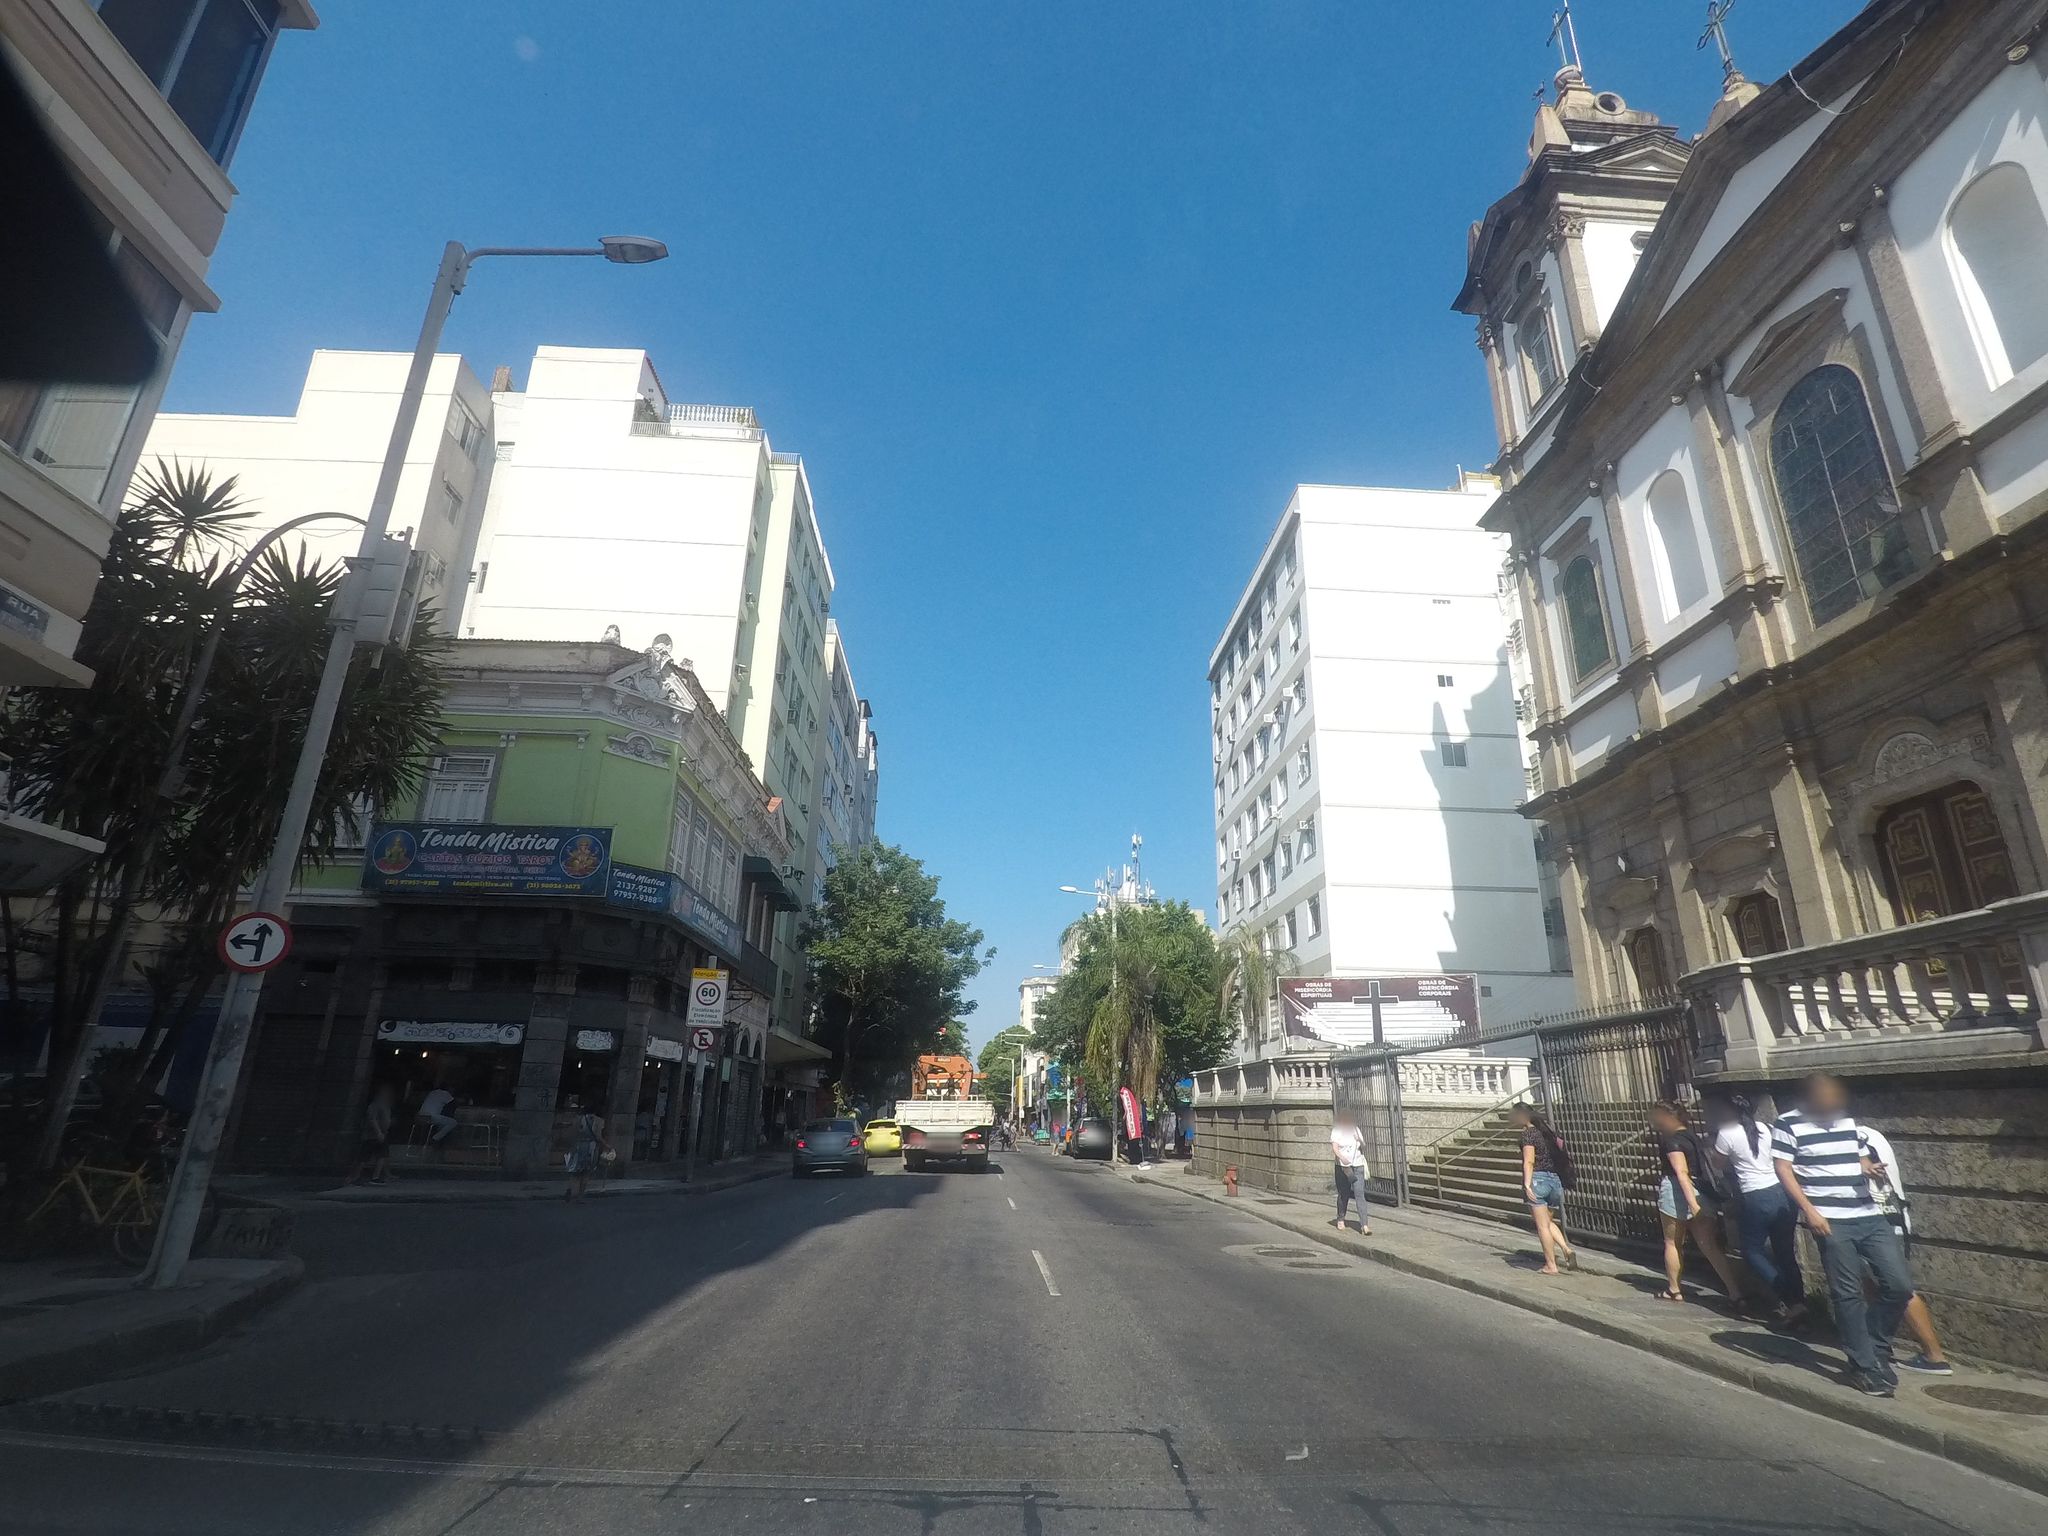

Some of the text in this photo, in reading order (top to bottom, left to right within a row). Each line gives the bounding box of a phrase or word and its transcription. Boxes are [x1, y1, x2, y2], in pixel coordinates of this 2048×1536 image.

[6, 596, 39, 620] RUA
[420, 828, 560, 853] Tenda Mística
[417, 852, 463, 864] CARTAS
[517, 853, 556, 865] TAROT
[612, 868, 636, 881] Tenda
[616, 881, 657, 895] 2137-9287
[613, 889, 658, 904] 97957-9388
[692, 895, 711, 920] Tenda
[701, 987, 716, 998] 60
